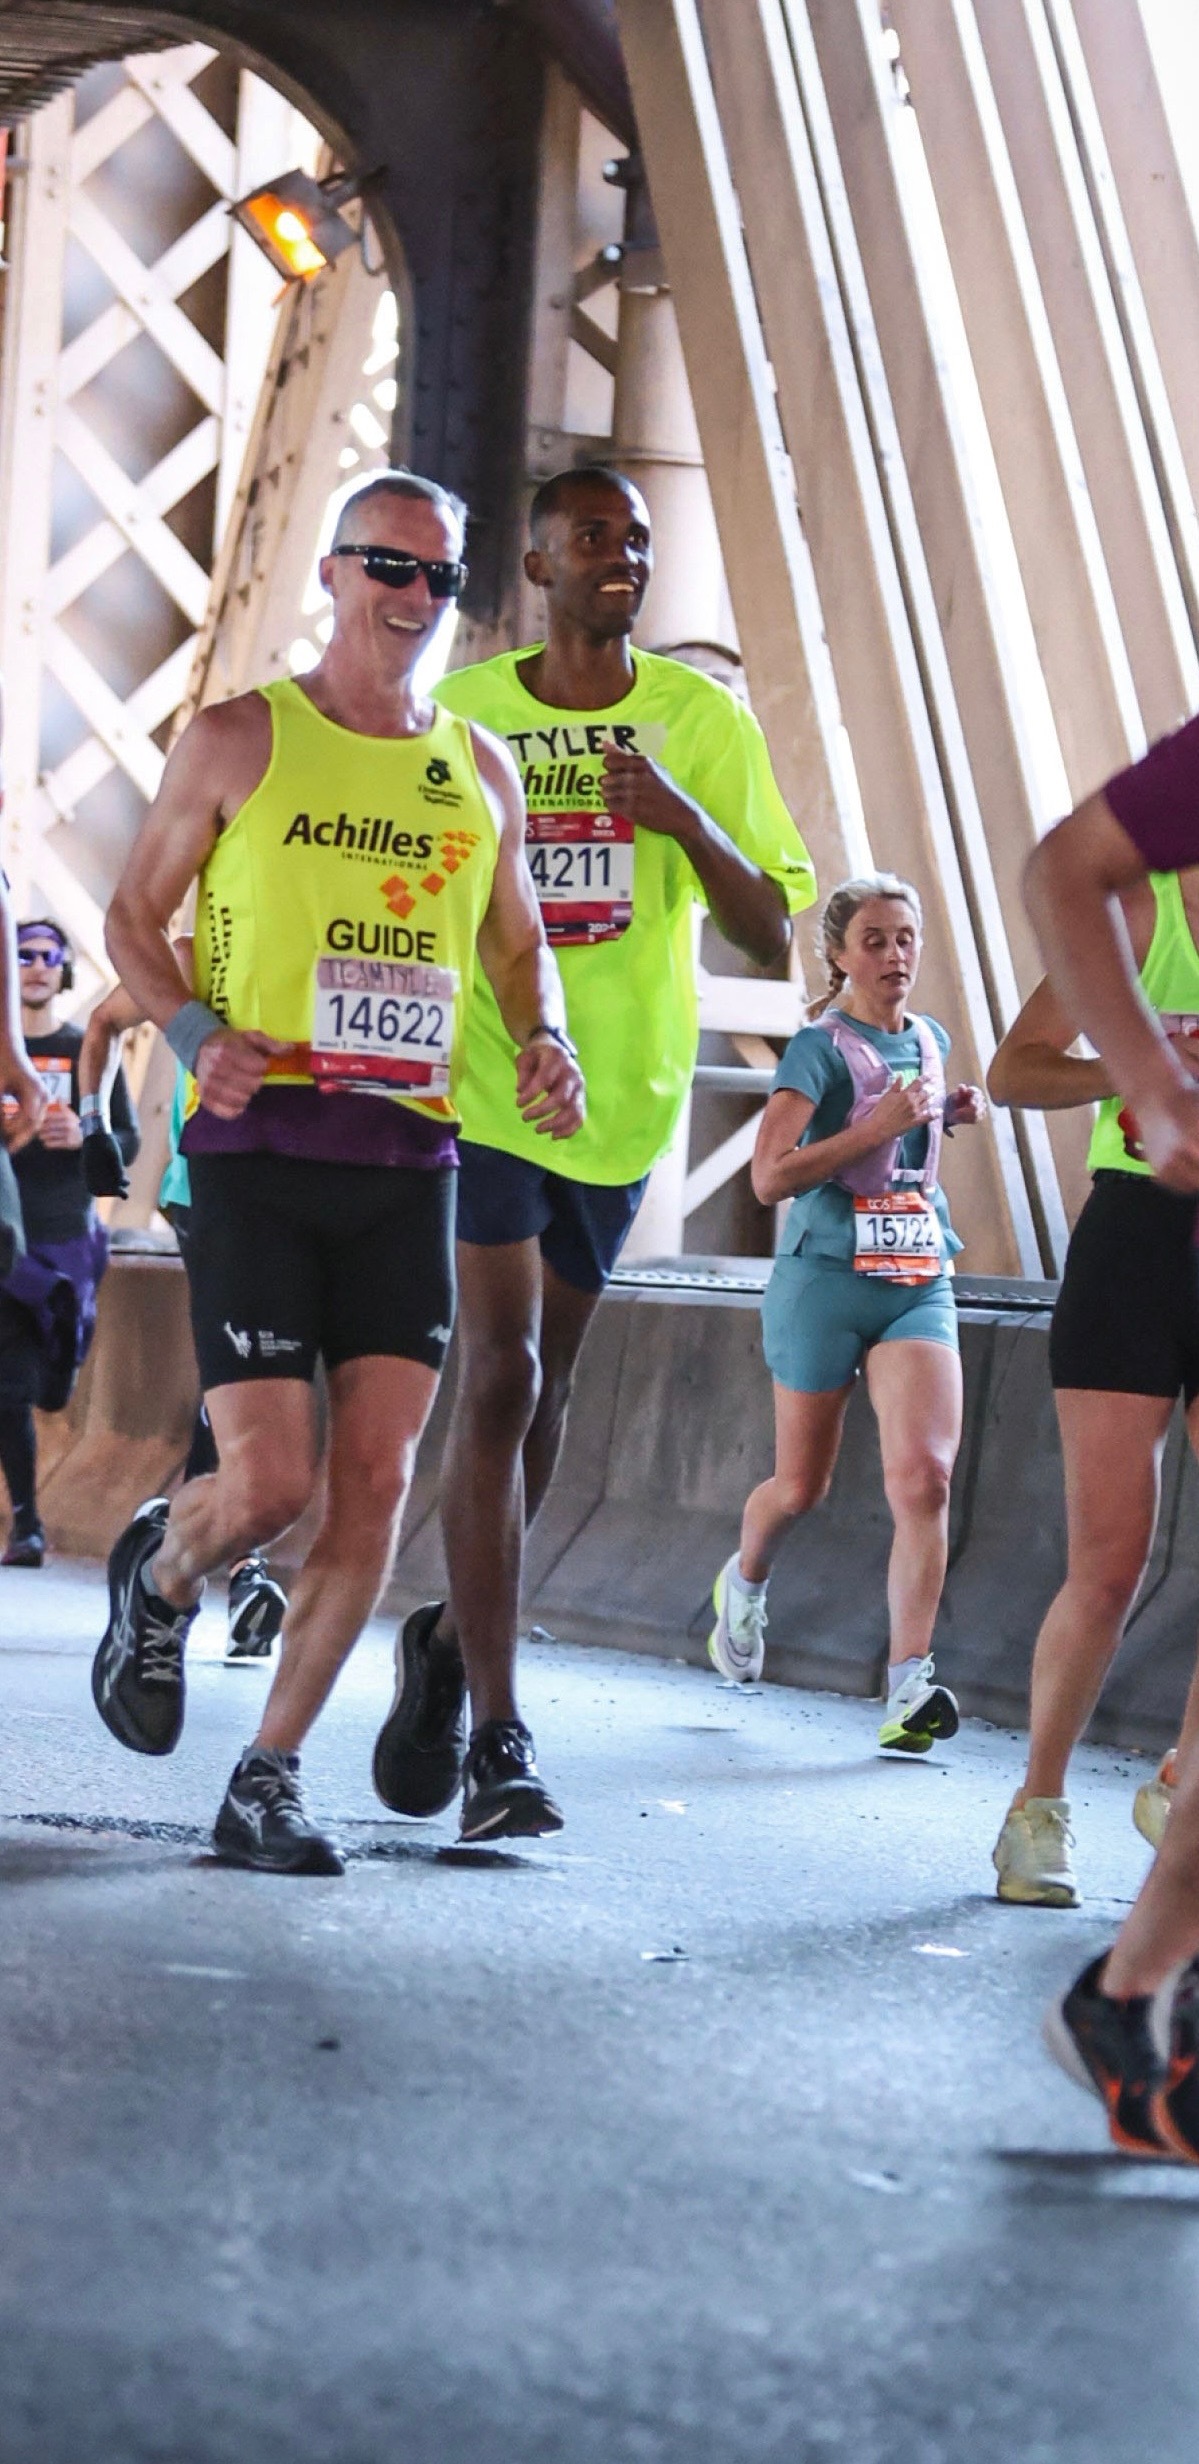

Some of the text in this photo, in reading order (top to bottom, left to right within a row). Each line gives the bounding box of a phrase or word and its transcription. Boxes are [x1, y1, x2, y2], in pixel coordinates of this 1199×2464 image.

[507, 725, 639, 762] TYLER
[283, 812, 434, 859] Achilles
[341, 851, 428, 871] INTERNATIONAL
[529, 846, 611, 888] 4211
[326, 918, 437, 963] GUIDE
[329, 994, 443, 1047] 14622
[866, 1216, 936, 1248] 15722
